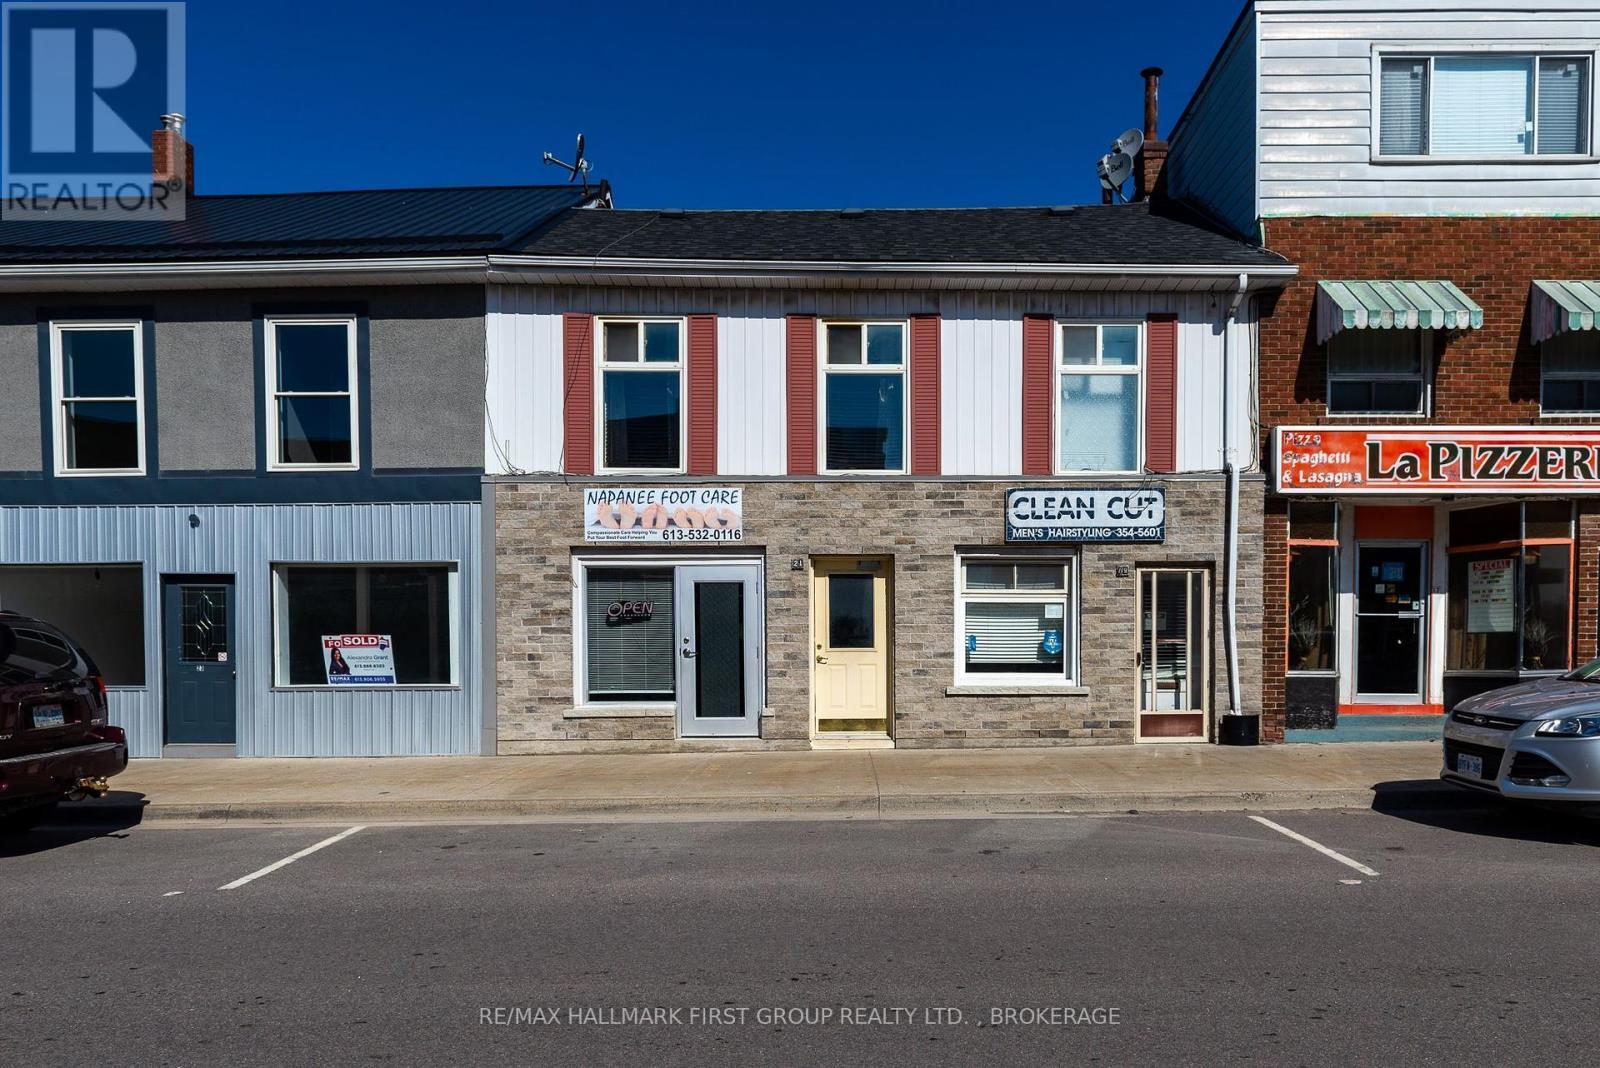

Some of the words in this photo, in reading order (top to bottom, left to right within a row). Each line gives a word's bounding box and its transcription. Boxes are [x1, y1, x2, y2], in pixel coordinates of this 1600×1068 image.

[1283, 432, 1321, 446] Pizza
[1282, 450, 1351, 468] Spaghetti
[1364, 441, 1421, 480] La
[1282, 470, 1293, 483] &
[1298, 470, 1362, 487] Lasagna
[587, 490, 656, 505] NAPANEE
[661, 490, 697, 505] FOOT
[701, 489, 739, 504] CARE
[1013, 496, 1095, 520] CLEAN
[1107, 496, 1158, 520] CUT
[662, 529, 742, 541] 613-532-0116
[1012, 528, 1044, 538] MEN'S
[1048, 527, 1112, 538] HAIRSTYLING
[1116, 527, 1161, 538] 354-5601
[607, 601, 654, 617] OPEN
[343, 636, 378, 646] SOLD
